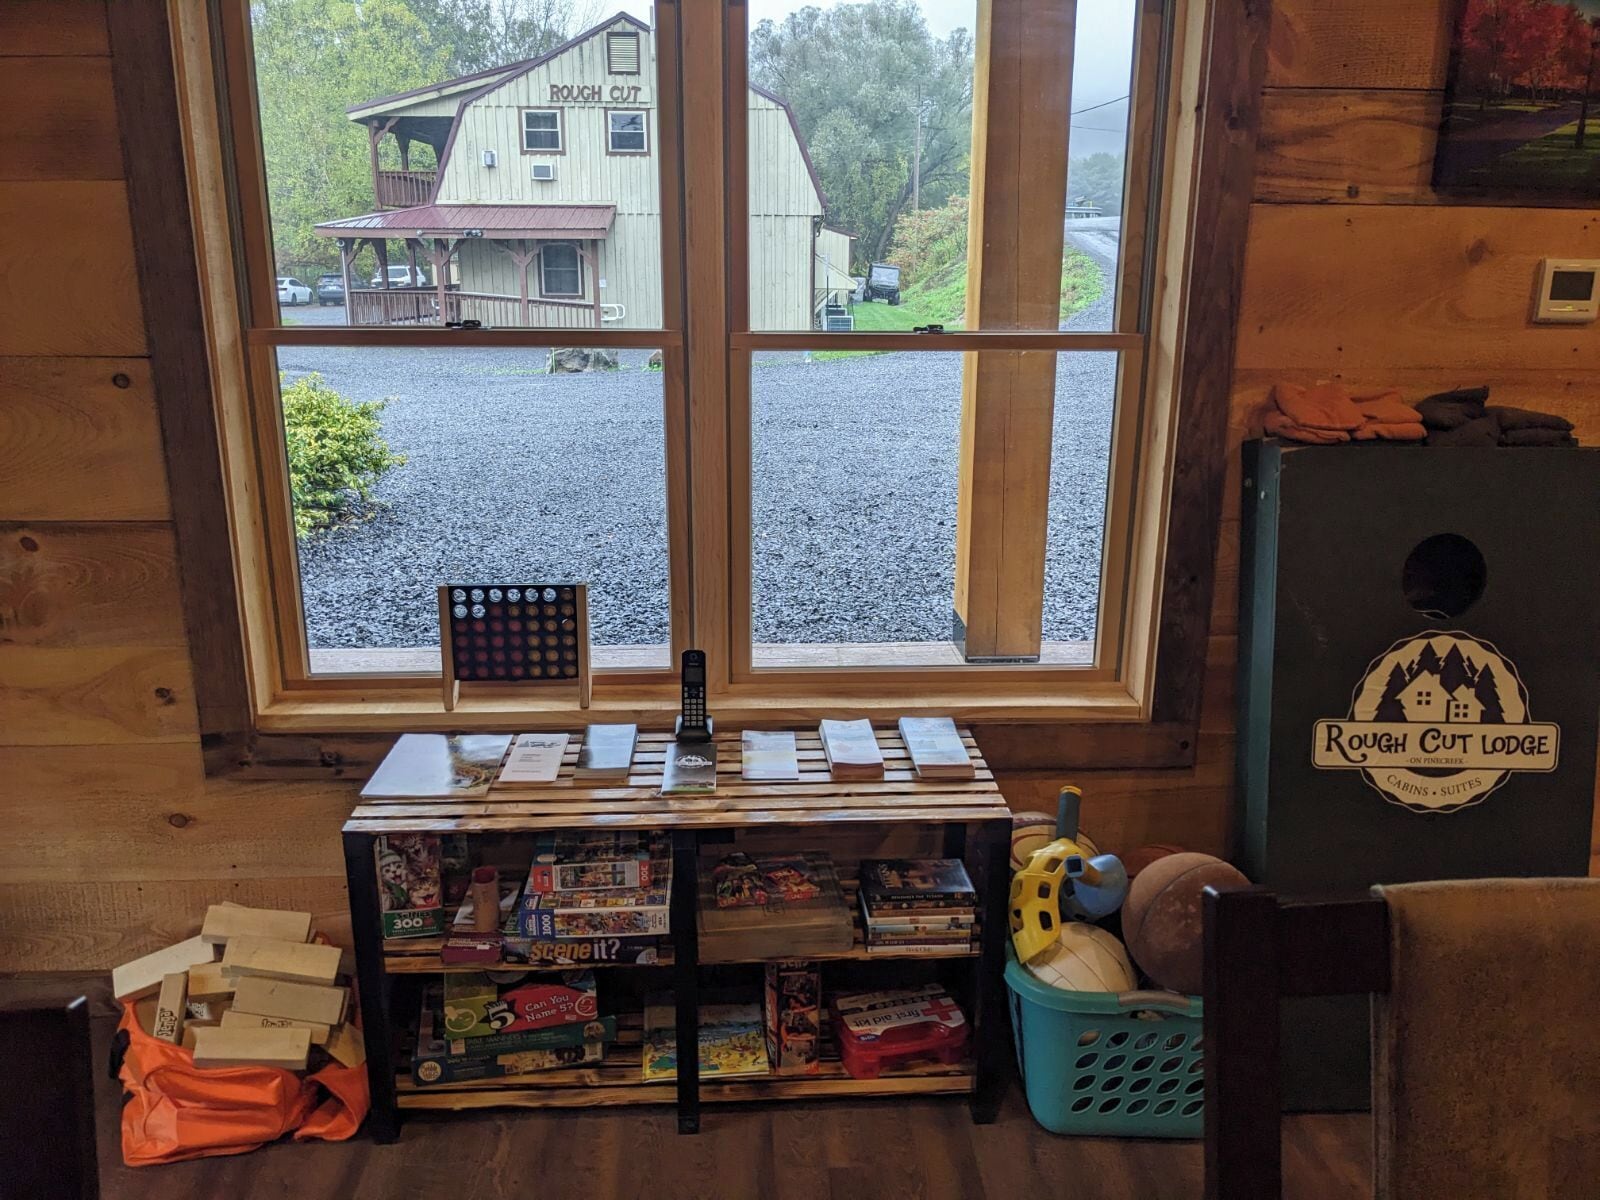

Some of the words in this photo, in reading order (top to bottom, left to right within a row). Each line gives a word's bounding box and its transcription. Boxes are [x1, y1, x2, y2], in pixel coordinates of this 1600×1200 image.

[549, 84, 602, 101] ROUGH
[609, 85, 642, 102] CUT
[1325, 724, 1408, 763] ROUGH
[1419, 728, 1473, 754] CUT
[1481, 734, 1550, 756] LODGE
[1386, 774, 1428, 797] CABINS
[1440, 776, 1483, 796] SUITES
[393, 918, 423, 929] 300
[541, 914, 552, 936] 1000
[530, 943, 592, 961] scene
[592, 938, 621, 960] it?
[525, 1000, 547, 1011] Can
[549, 995, 569, 1004] You
[525, 1009, 557, 1023] Name
[559, 1002, 574, 1012] 5?
[157, 1010, 177, 1036] Jenga
[488, 1002, 516, 1030] 5
[852, 1018, 871, 1028] kit
[873, 1014, 892, 1024] aid
[895, 1009, 920, 1020] first
